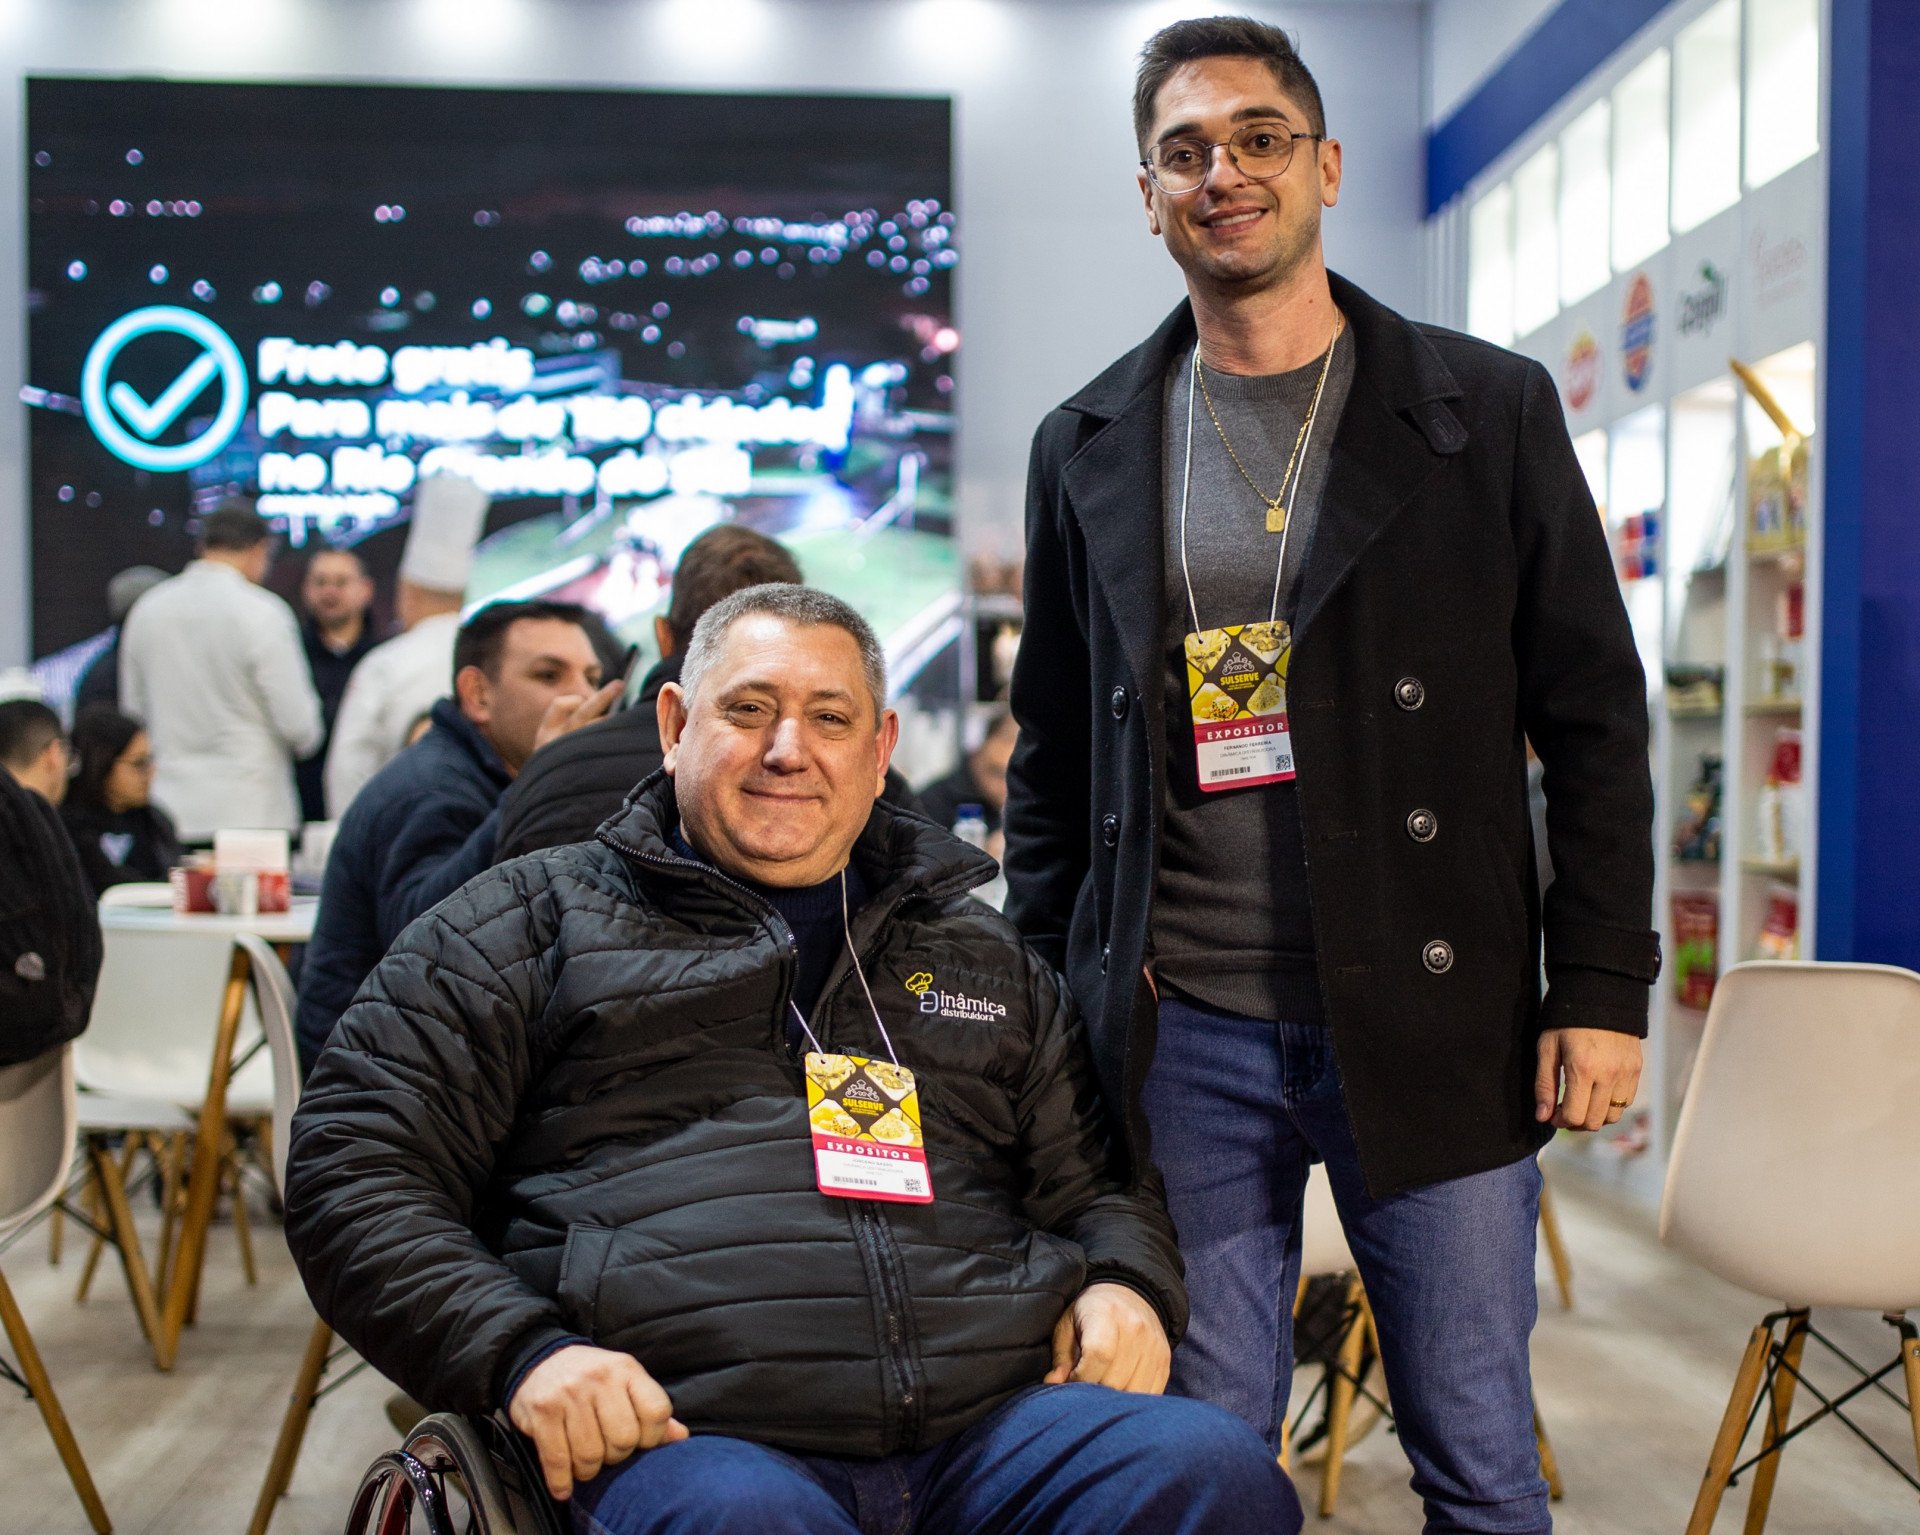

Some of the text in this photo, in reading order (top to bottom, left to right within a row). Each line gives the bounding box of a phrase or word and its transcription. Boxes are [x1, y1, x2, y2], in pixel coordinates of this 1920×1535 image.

[1219, 672, 1260, 686] SULSERVE
[1206, 722, 1285, 741] EXPOSITOR
[940, 1008, 995, 1022] distribuidora
[842, 1097, 885, 1112] SULSERVE
[827, 1141, 911, 1160] EXPOSITOR
